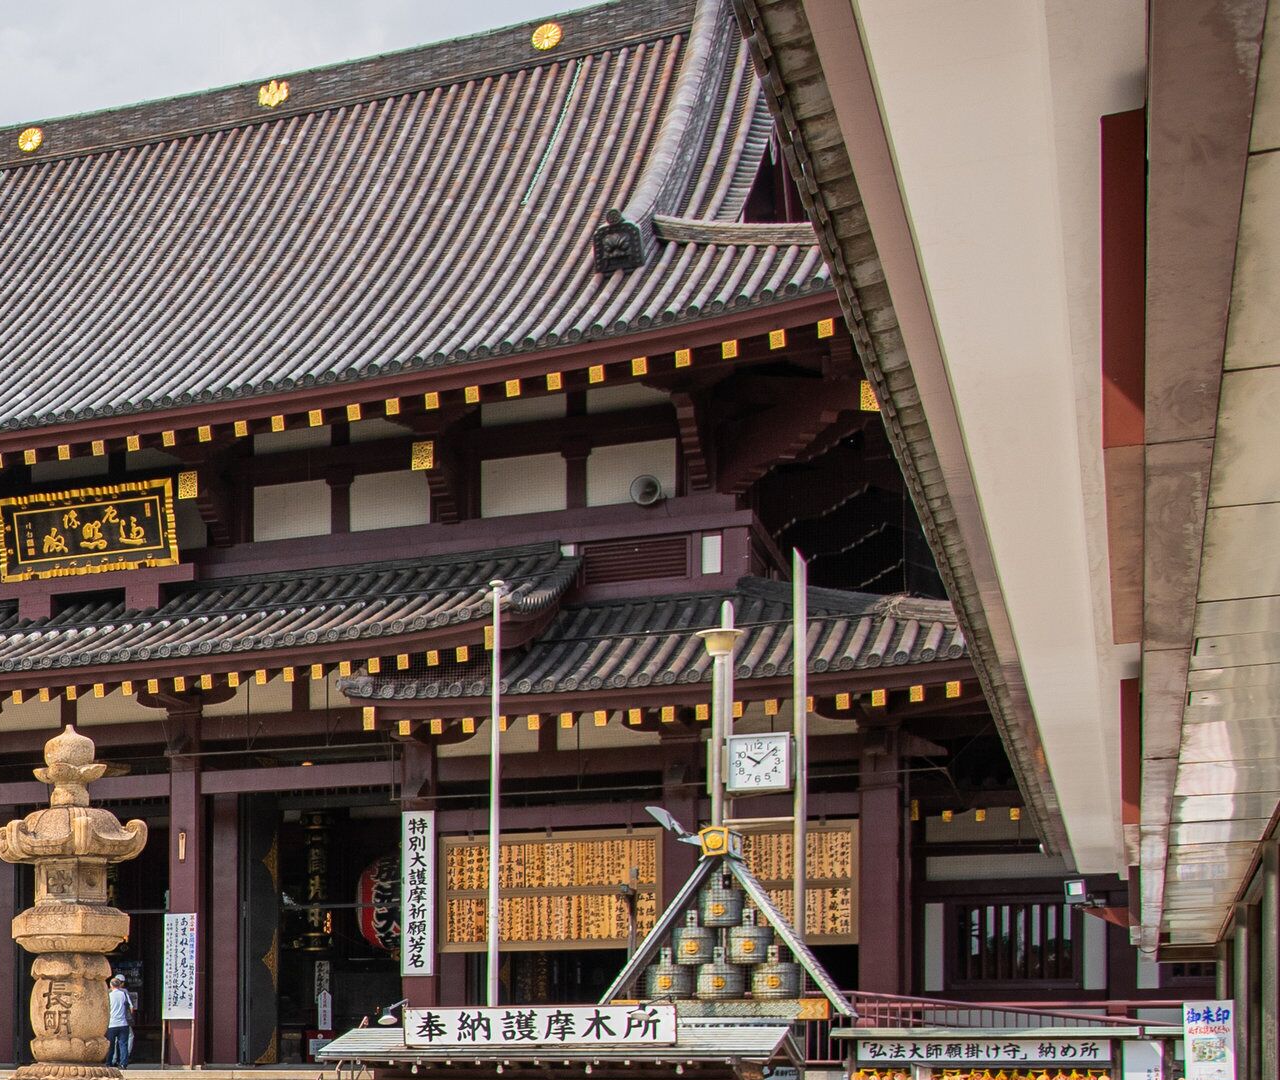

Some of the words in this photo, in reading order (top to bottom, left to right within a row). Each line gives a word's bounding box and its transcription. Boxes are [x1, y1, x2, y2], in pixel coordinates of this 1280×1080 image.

[407, 817, 429, 970] 特別大護摩祈願芳名
[42, 981, 73, 1034] 長明
[416, 1010, 662, 1042] 奉納護摩木所
[1186, 1006, 1230, 1025] 御朱印
